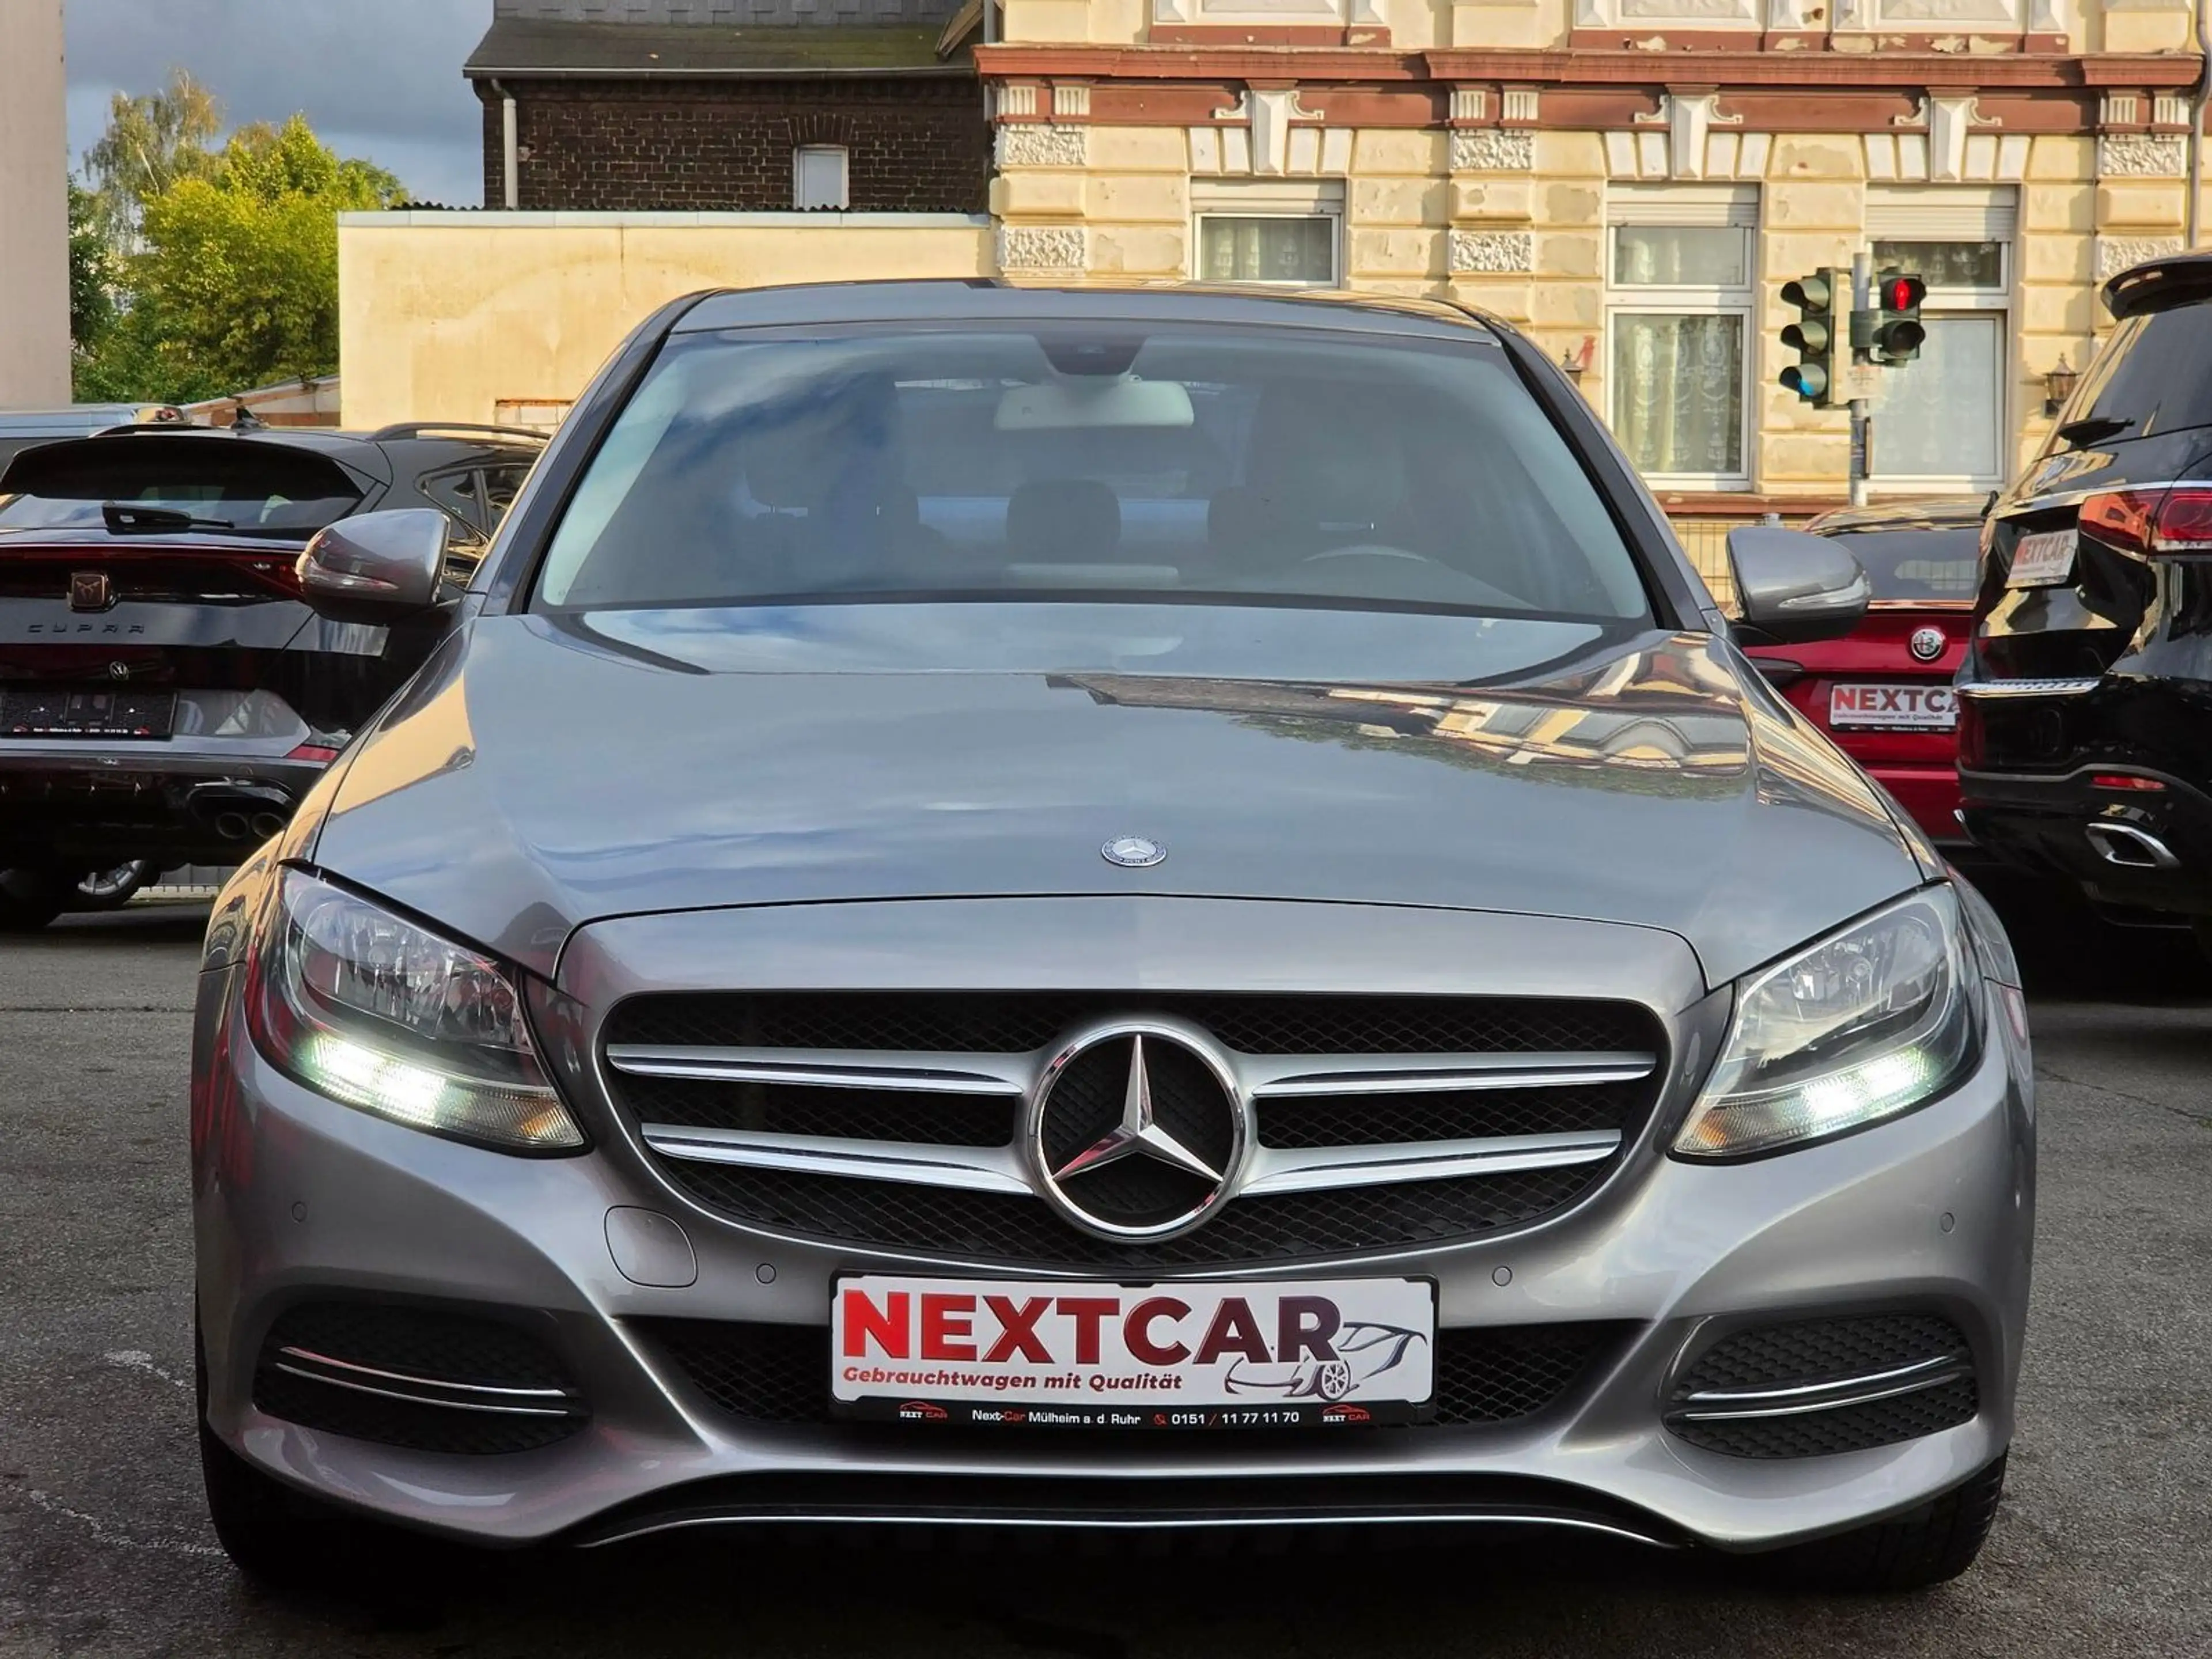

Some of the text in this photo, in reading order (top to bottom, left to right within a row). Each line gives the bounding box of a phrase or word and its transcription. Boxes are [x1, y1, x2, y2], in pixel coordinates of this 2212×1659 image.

[843, 1289, 1341, 1366] NEXTCAR
[843, 1367, 1183, 1392] Gebrauchtwagen mit Qualität
[972, 1410, 1025, 1422] Next-Car
[1028, 1411, 1080, 1423] Mülheim
[1111, 1414, 1141, 1425] Ruhr
[1171, 1414, 1205, 1425] 0151
[1222, 1414, 1237, 1424] 11
[1242, 1413, 1258, 1423] 77
[1263, 1413, 1278, 1423] 11
[1283, 1412, 1300, 1423] 70
